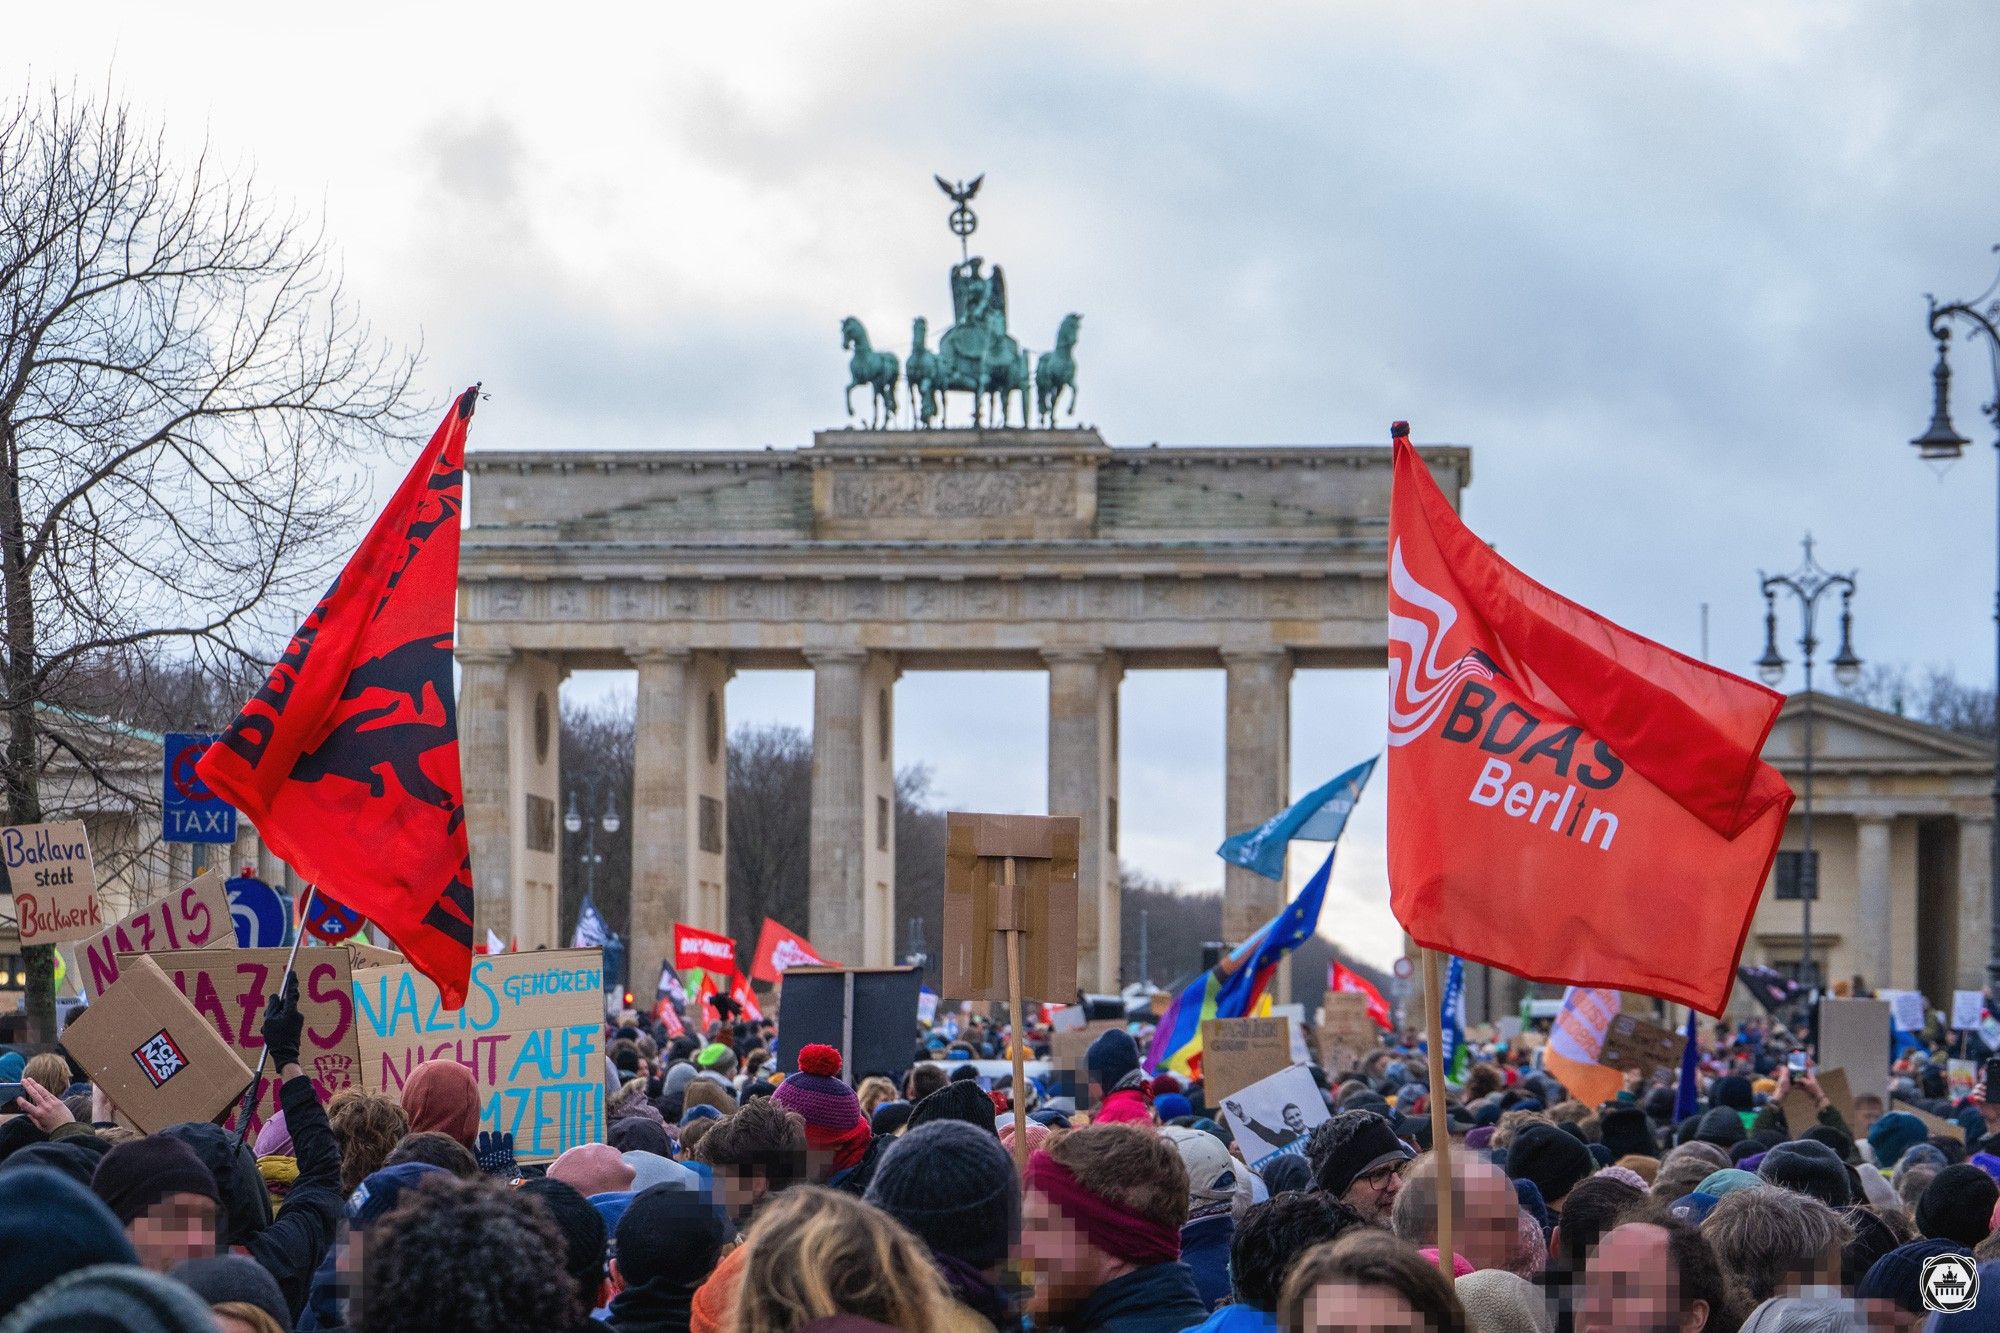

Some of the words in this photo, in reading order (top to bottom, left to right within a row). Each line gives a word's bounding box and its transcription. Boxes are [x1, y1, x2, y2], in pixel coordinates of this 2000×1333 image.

[170, 811, 229, 833] TAXI
[1468, 757, 1619, 851] Berlin
[2, 828, 86, 868] Baklava
[35, 866, 74, 887] statt
[16, 893, 101, 938] Backwerk
[174, 963, 353, 1050] AZS
[503, 968, 600, 1007] GEHÖREN
[140, 1041, 173, 1080] NZS
[151, 1033, 184, 1073] FCK
[508, 1024, 599, 1082] AUF
